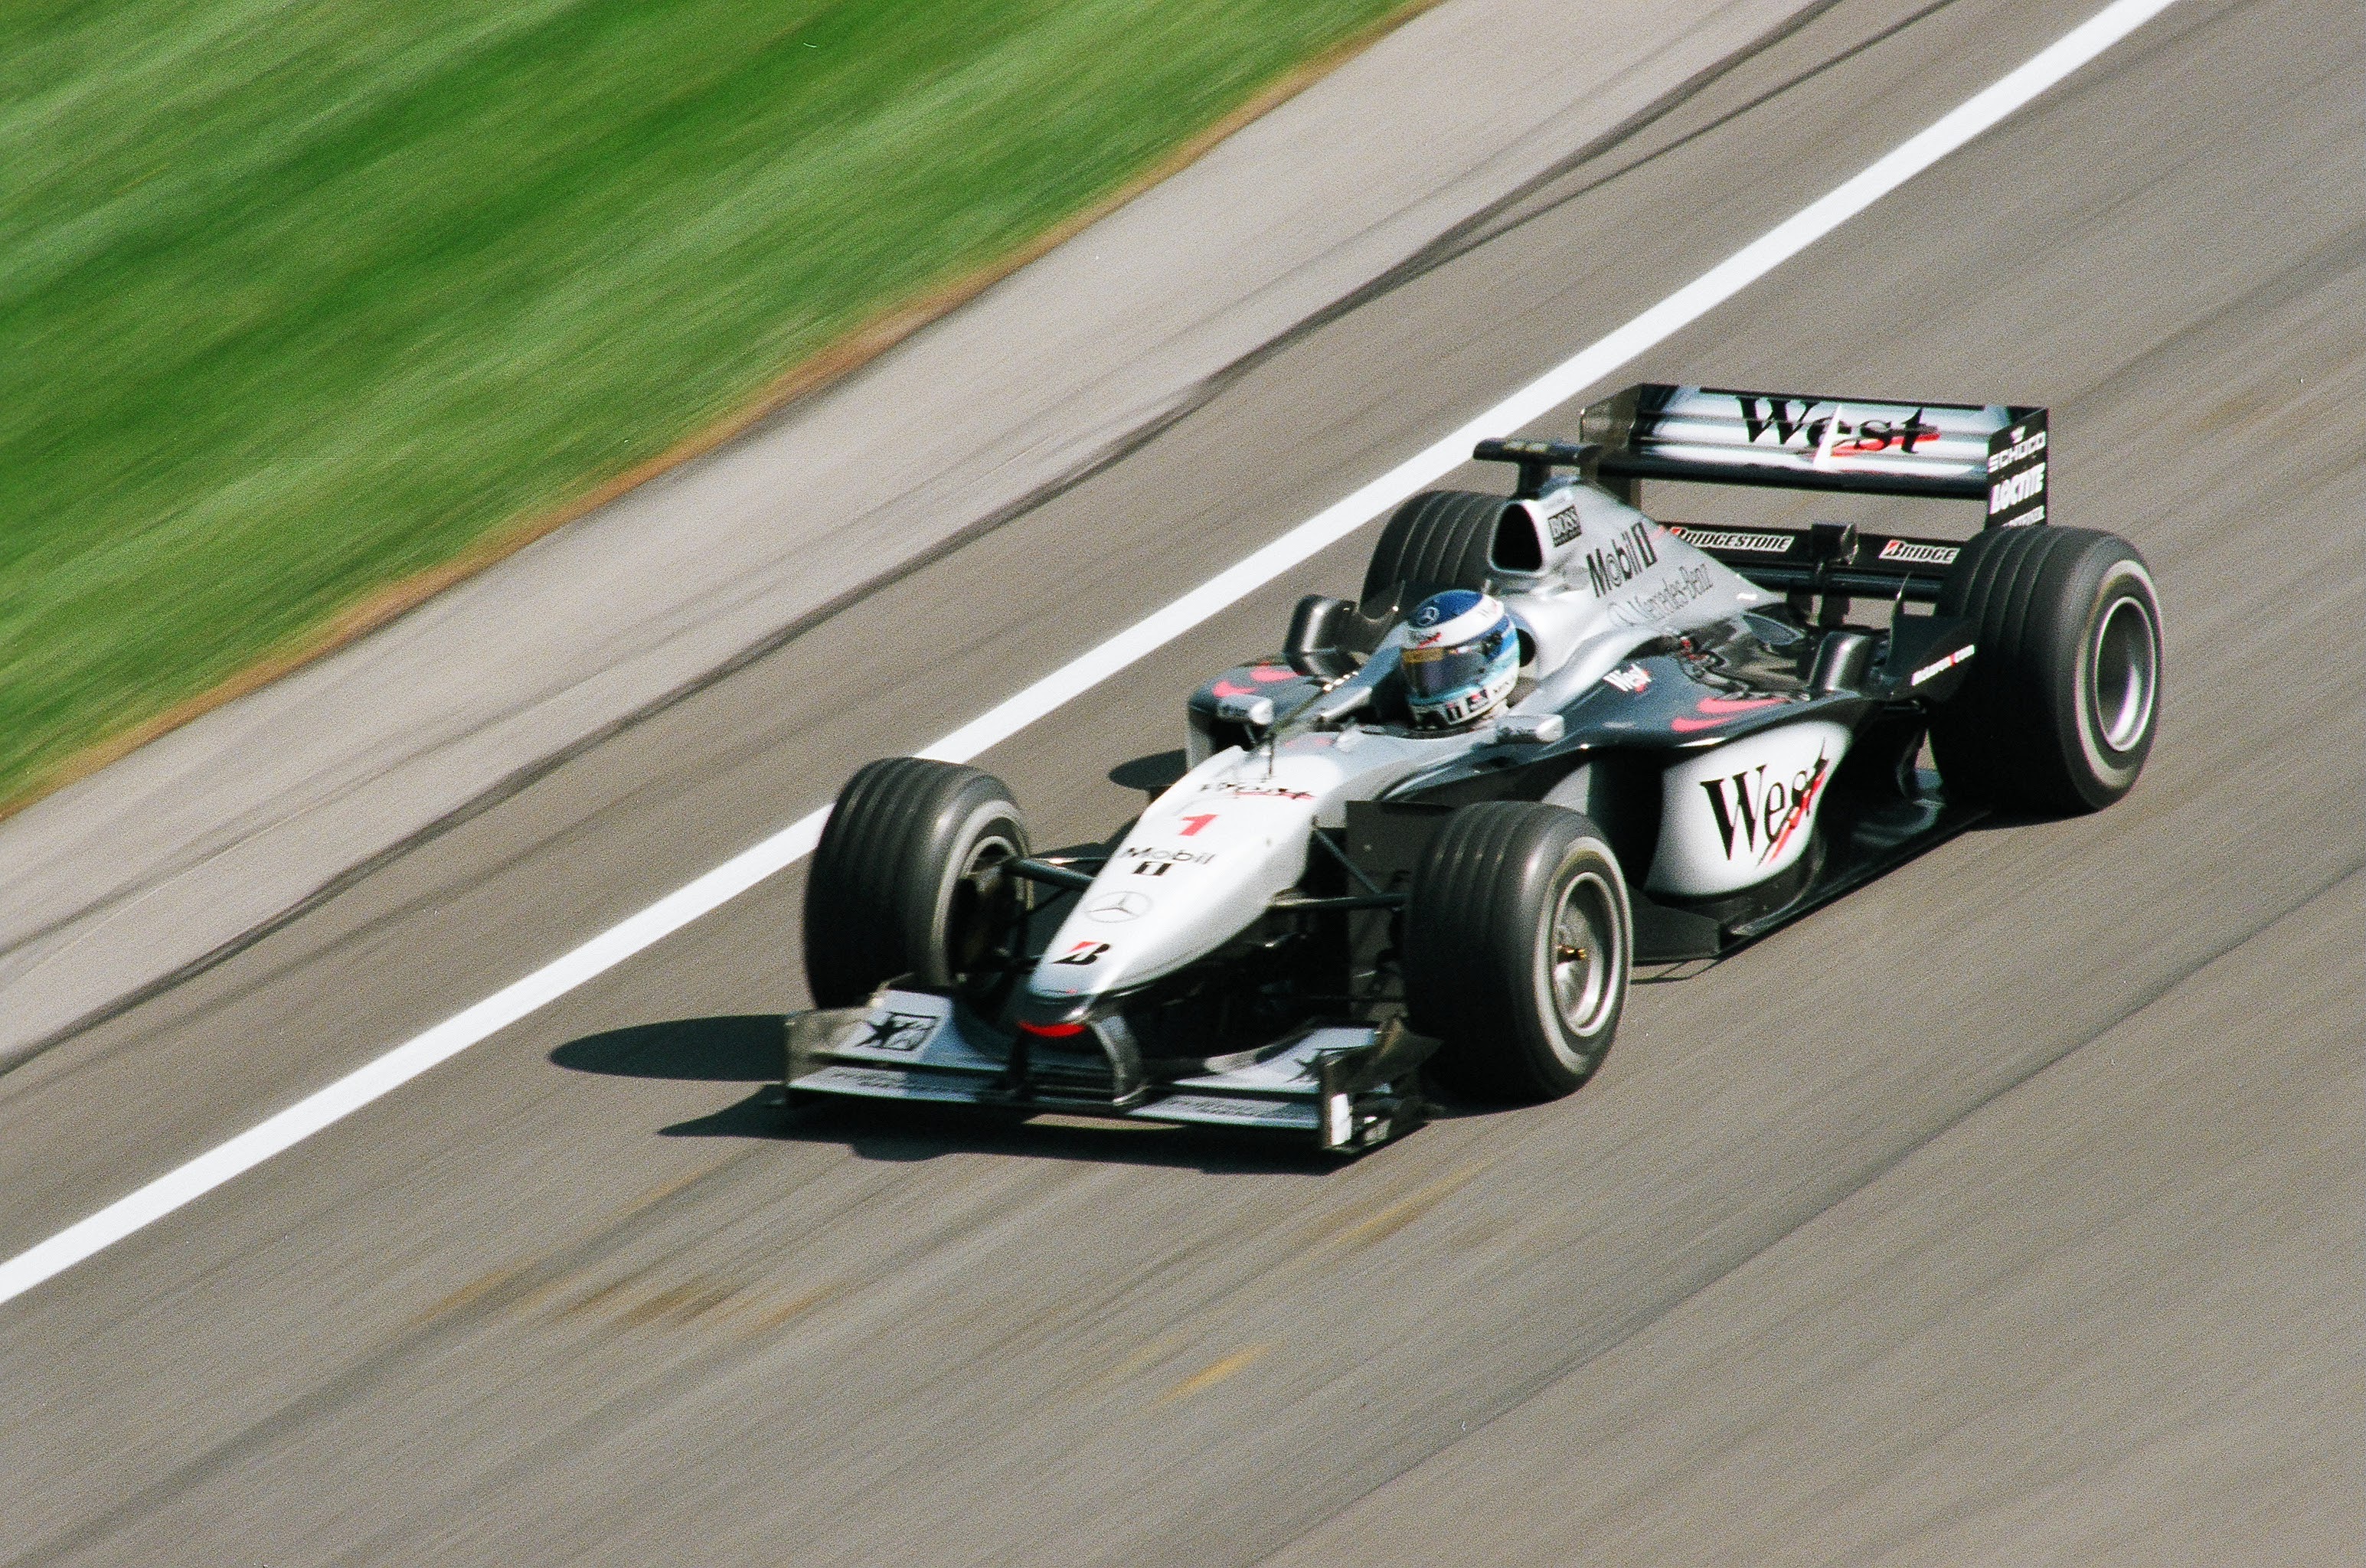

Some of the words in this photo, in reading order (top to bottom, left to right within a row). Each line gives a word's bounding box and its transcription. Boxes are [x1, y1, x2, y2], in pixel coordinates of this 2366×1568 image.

[1735, 396, 1926, 454] West
[1586, 530, 1642, 599] Mobil
[1179, 814, 1220, 836] 1
[1699, 744, 1829, 864] West
[1123, 847, 1215, 864] Mobil
